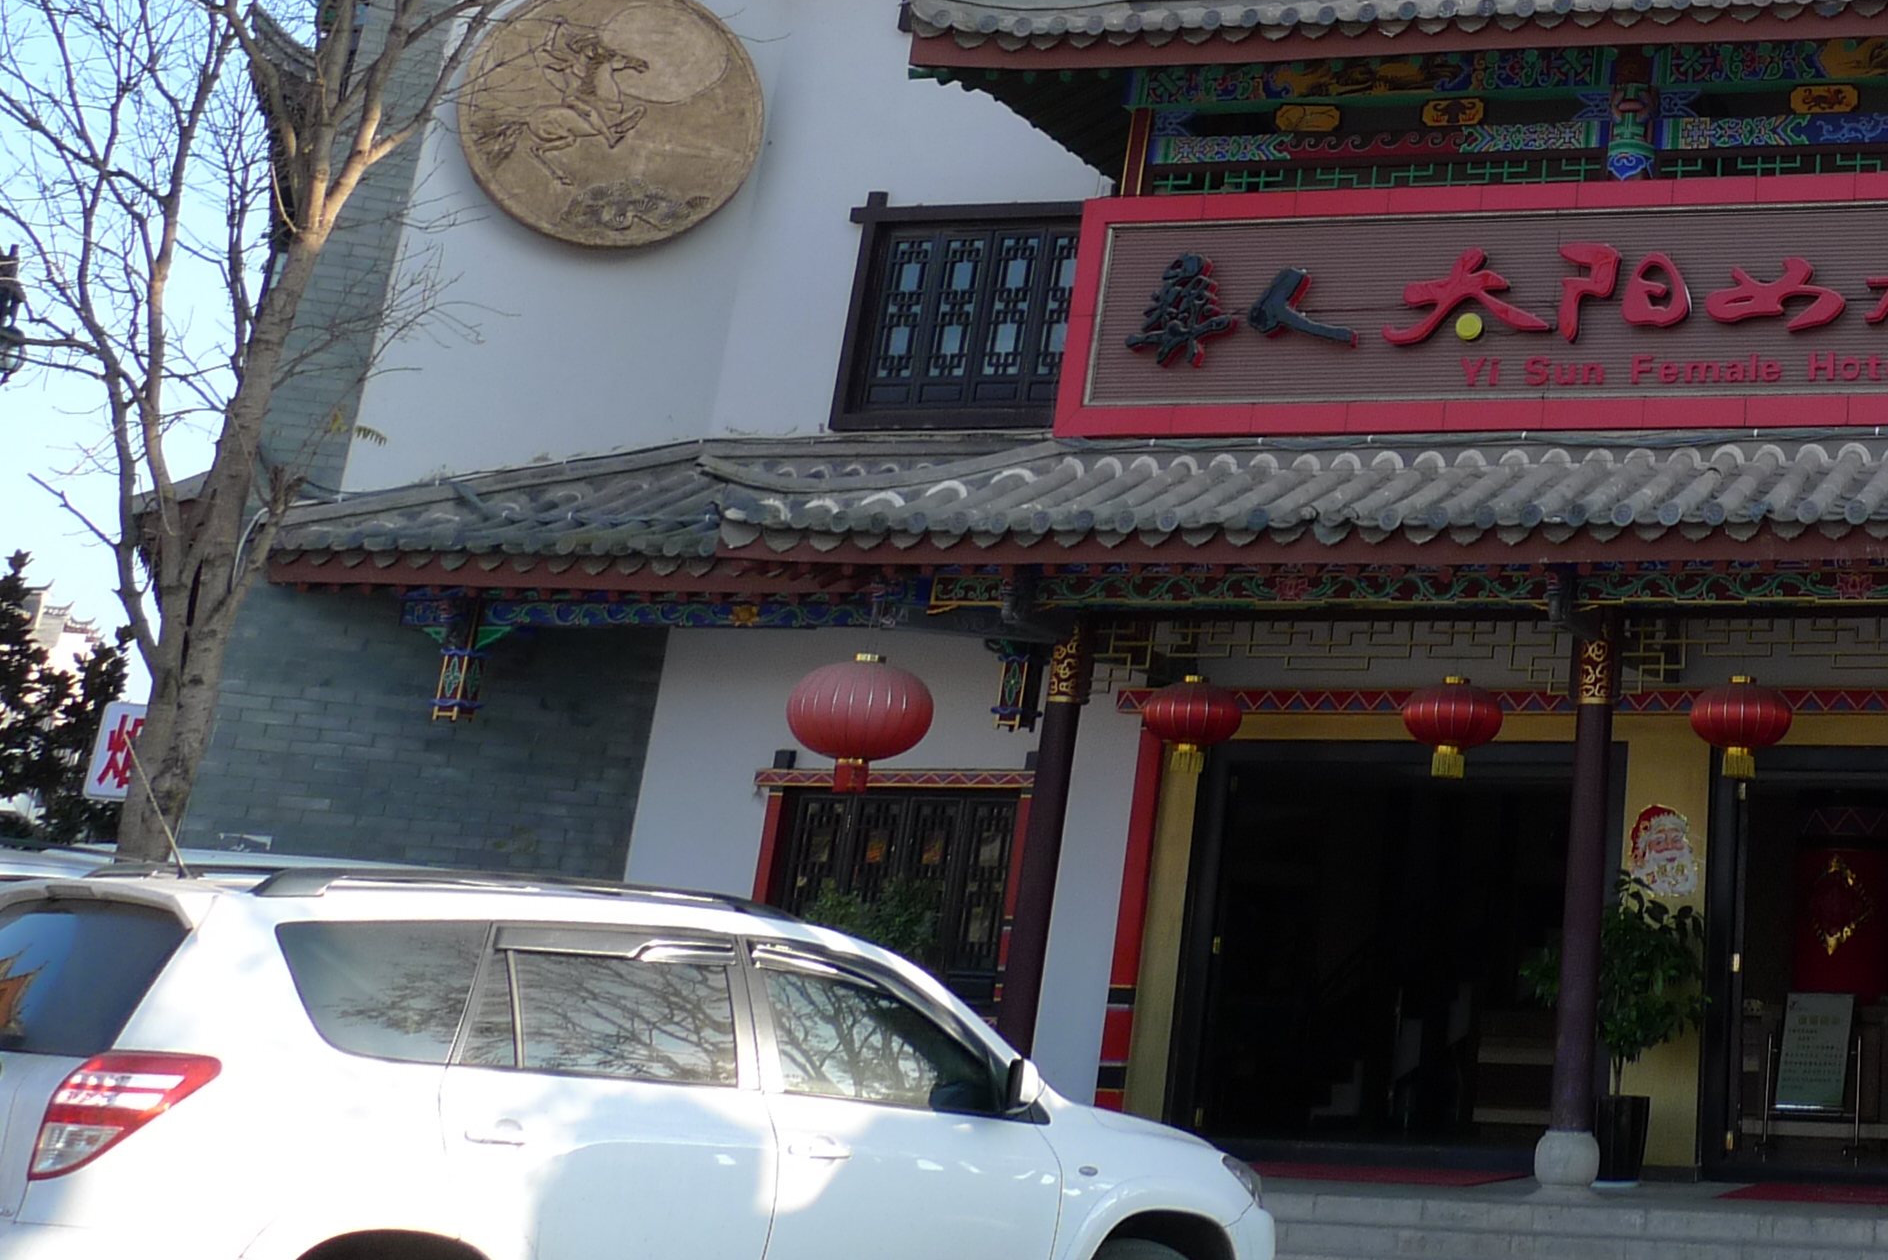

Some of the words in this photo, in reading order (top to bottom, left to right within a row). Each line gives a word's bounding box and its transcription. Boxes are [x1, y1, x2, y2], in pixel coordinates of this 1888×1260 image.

[1459, 355, 1501, 387] Yi
[1524, 354, 1606, 386] Sun
[1630, 351, 1783, 385] Female
